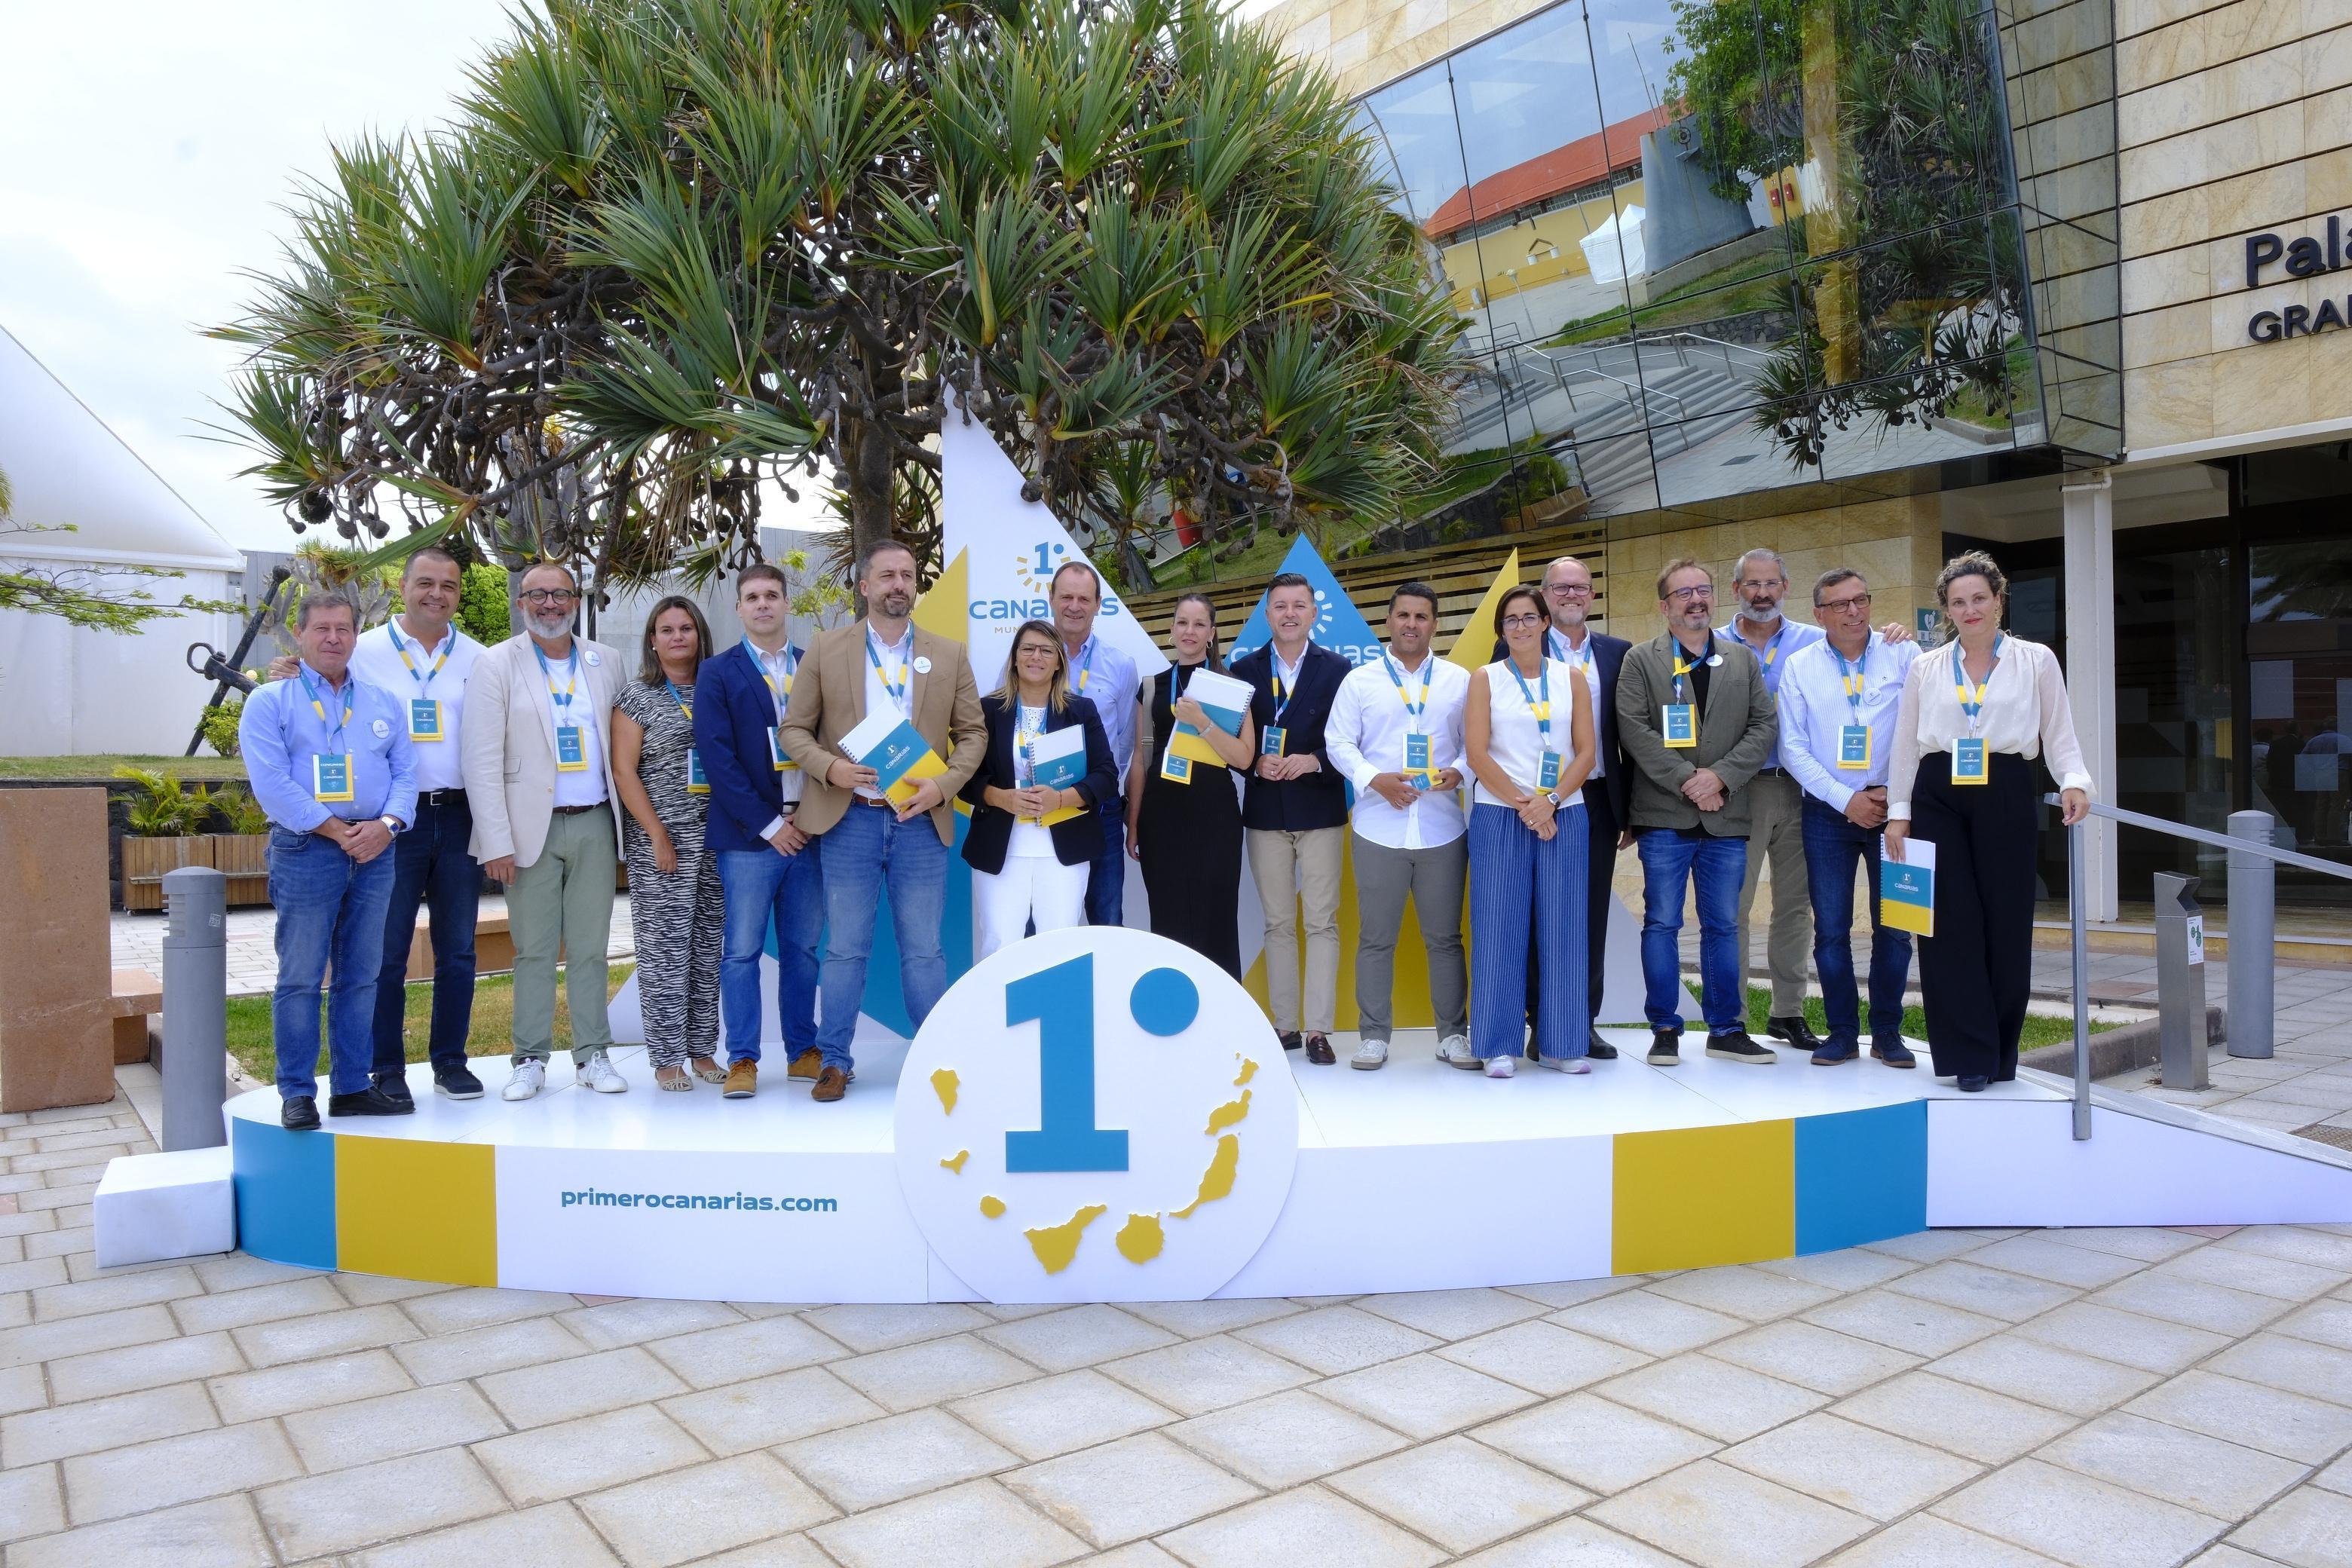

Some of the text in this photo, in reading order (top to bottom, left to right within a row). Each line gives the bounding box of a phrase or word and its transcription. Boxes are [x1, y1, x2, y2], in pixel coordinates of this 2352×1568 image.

[2246, 215, 2352, 287] Pal
[2248, 294, 2352, 344] GRA
[561, 1187, 838, 1212] primerocanarias.com
